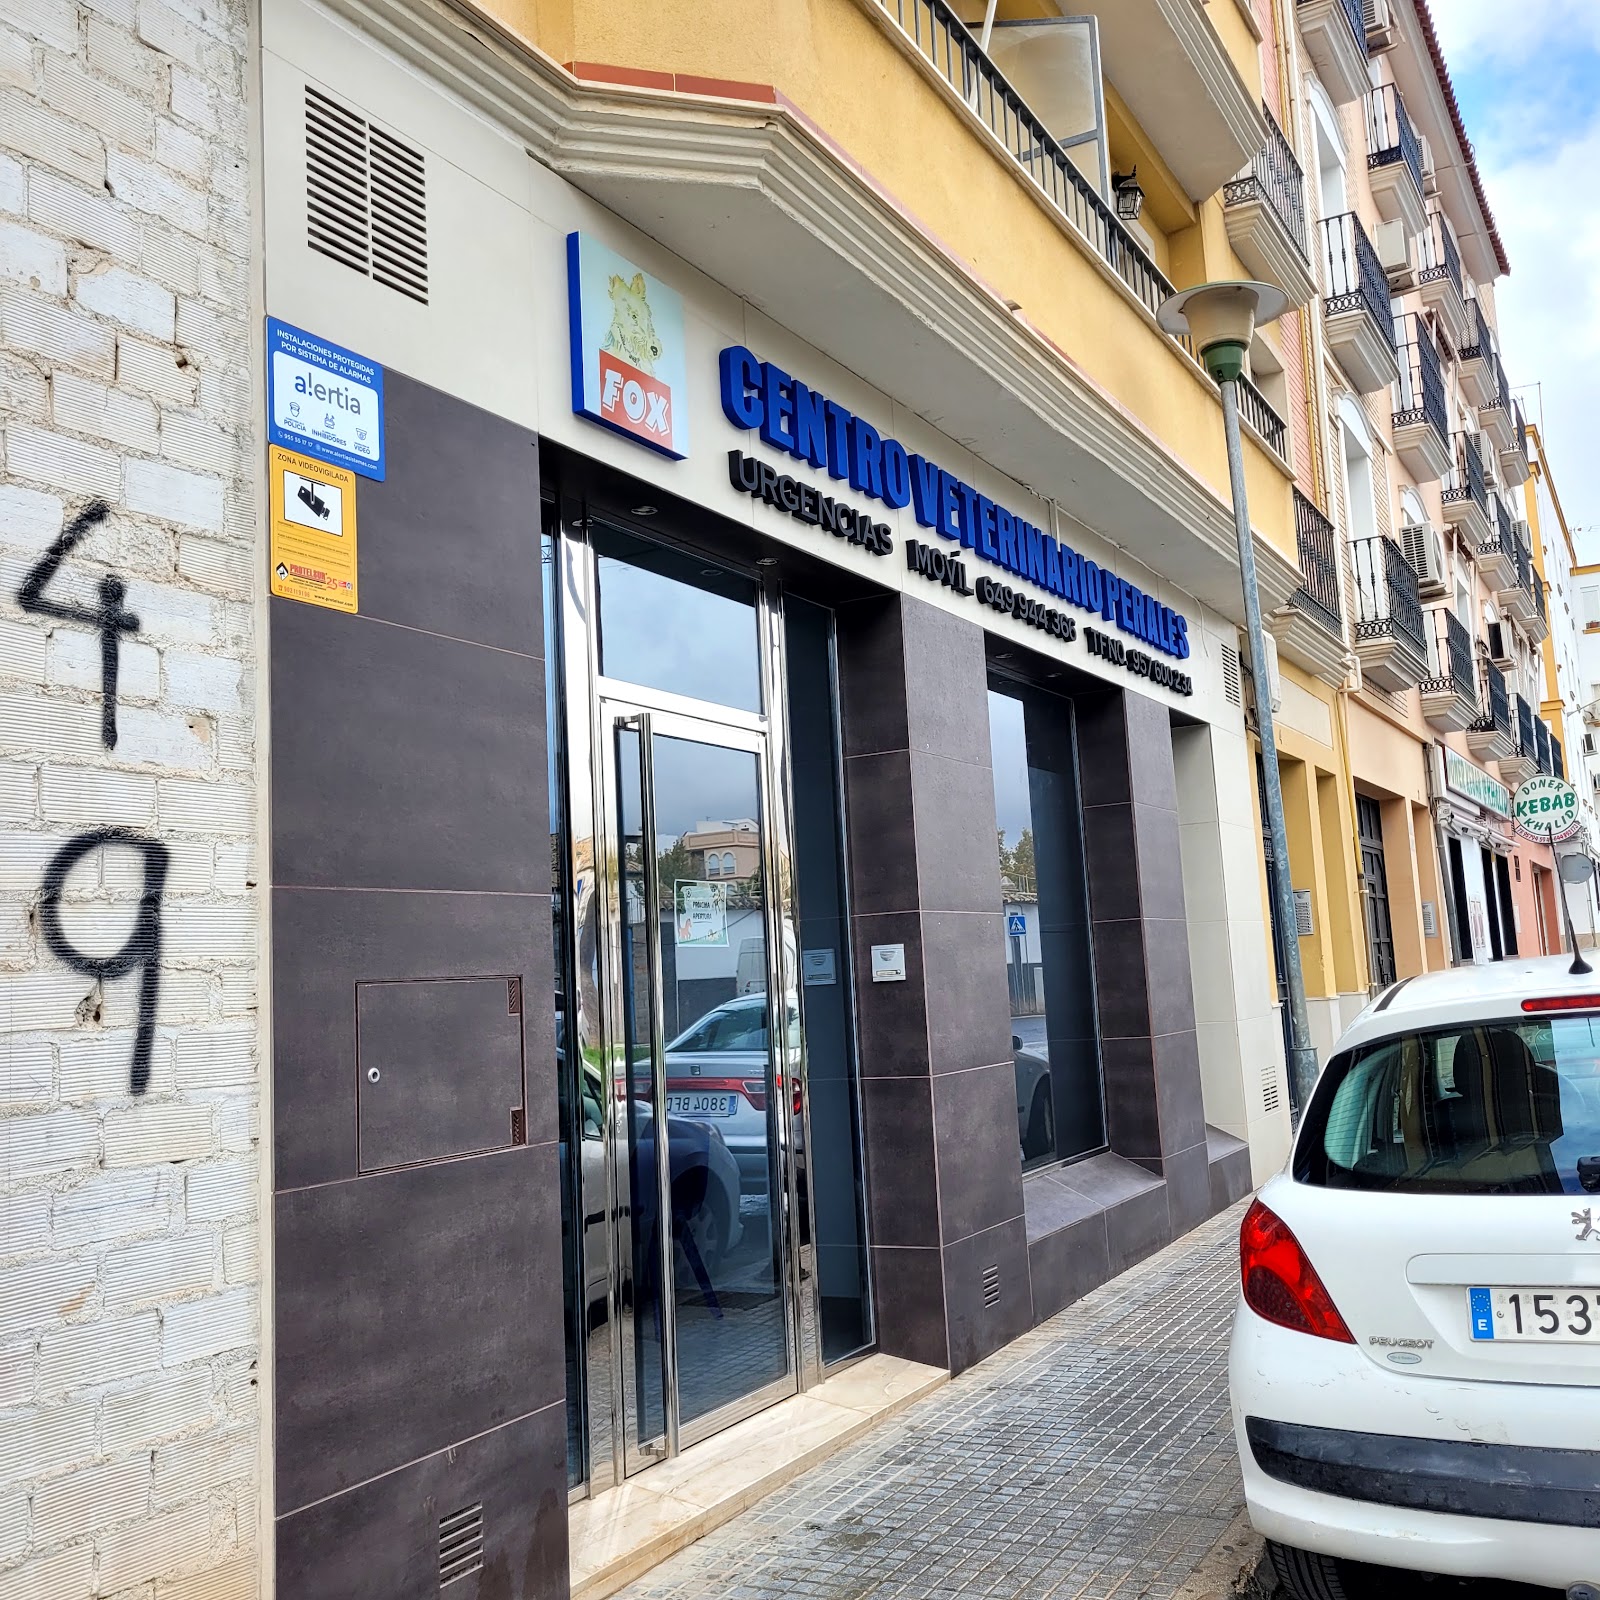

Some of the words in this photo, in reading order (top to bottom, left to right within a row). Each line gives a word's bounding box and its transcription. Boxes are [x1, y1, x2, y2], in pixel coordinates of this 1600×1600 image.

[277, 329, 332, 358] INSTALACIONES
[333, 353, 375, 376] PROTEGIDAS
[281, 341, 297, 353] POR
[298, 348, 328, 367] SISTEMA
[328, 360, 338, 370] DE
[339, 364, 371, 384] ALARMAS
[602, 369, 671, 437] FOX
[312, 429, 347, 447] INHIBIDORES
[277, 453, 297, 466] ZONA
[298, 460, 349, 483] VIDEOVIGILADA
[719, 345, 911, 510] CENTRO
[908, 454, 1103, 614] VETERINARIO
[1100, 569, 1190, 660] PERALES
[326, 577, 338, 590] 25
[728, 449, 894, 556] URGENCIAS
[976, 576, 1015, 613] 649
[1012, 593, 1048, 629] 944
[1047, 609, 1077, 642] 366
[1126, 649, 1151, 678] 957
[1152, 660, 1175, 687] 600
[1171, 671, 1194, 696] 234
[18, 500, 140, 750] 4
[1516, 792, 1576, 817] KEBAB
[1521, 779, 1564, 795] DONER
[1523, 810, 1574, 831] KHALID
[39, 826, 169, 1095] 9
[1477, 1319, 1488, 1331] E
[1508, 1294, 1600, 1336] 153
[1369, 1335, 1435, 1349] PEUGEOT
